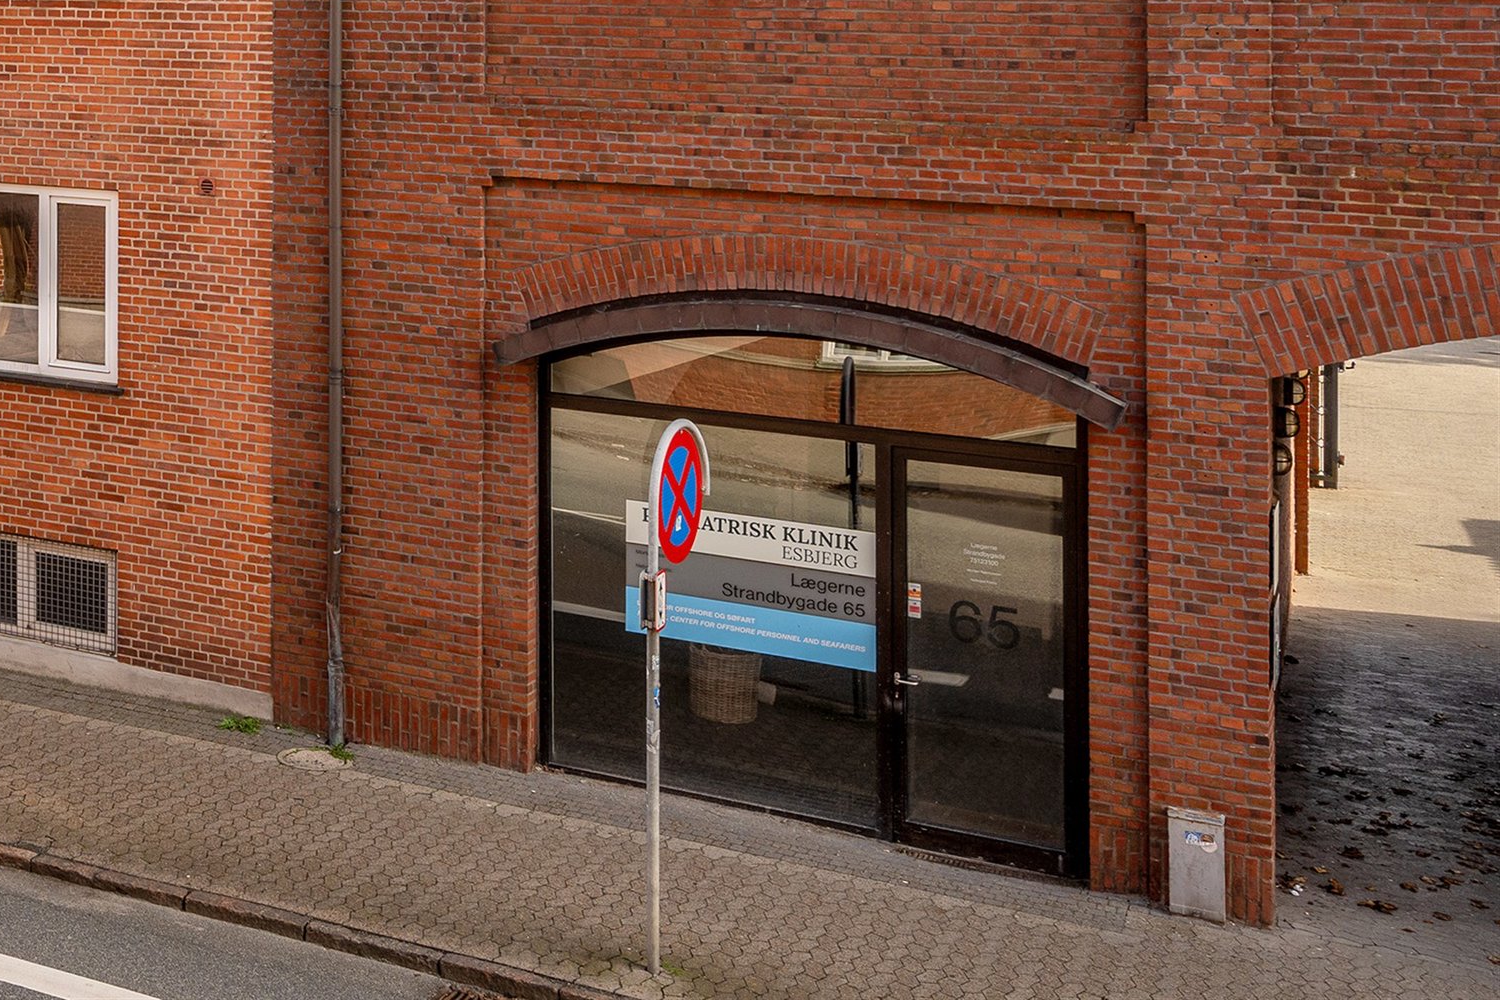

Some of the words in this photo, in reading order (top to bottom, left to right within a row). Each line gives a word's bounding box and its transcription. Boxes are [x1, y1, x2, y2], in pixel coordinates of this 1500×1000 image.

[782, 526, 859, 551] KLINIK
[782, 546, 858, 569] ESBJERG
[791, 573, 866, 597] Lægerne
[674, 605, 713, 619] OFFSHORE
[714, 612, 726, 620] OG
[722, 582, 838, 613] Strandbygade
[843, 601, 866, 618] 65
[669, 615, 699, 625] CENTER
[700, 620, 715, 628] FOR
[716, 623, 756, 636] OFFSHORE
[756, 629, 802, 643] PERSONNEL
[803, 637, 820, 646] AND
[821, 639, 867, 653] SEAFARERS
[949, 600, 1020, 650] 65
